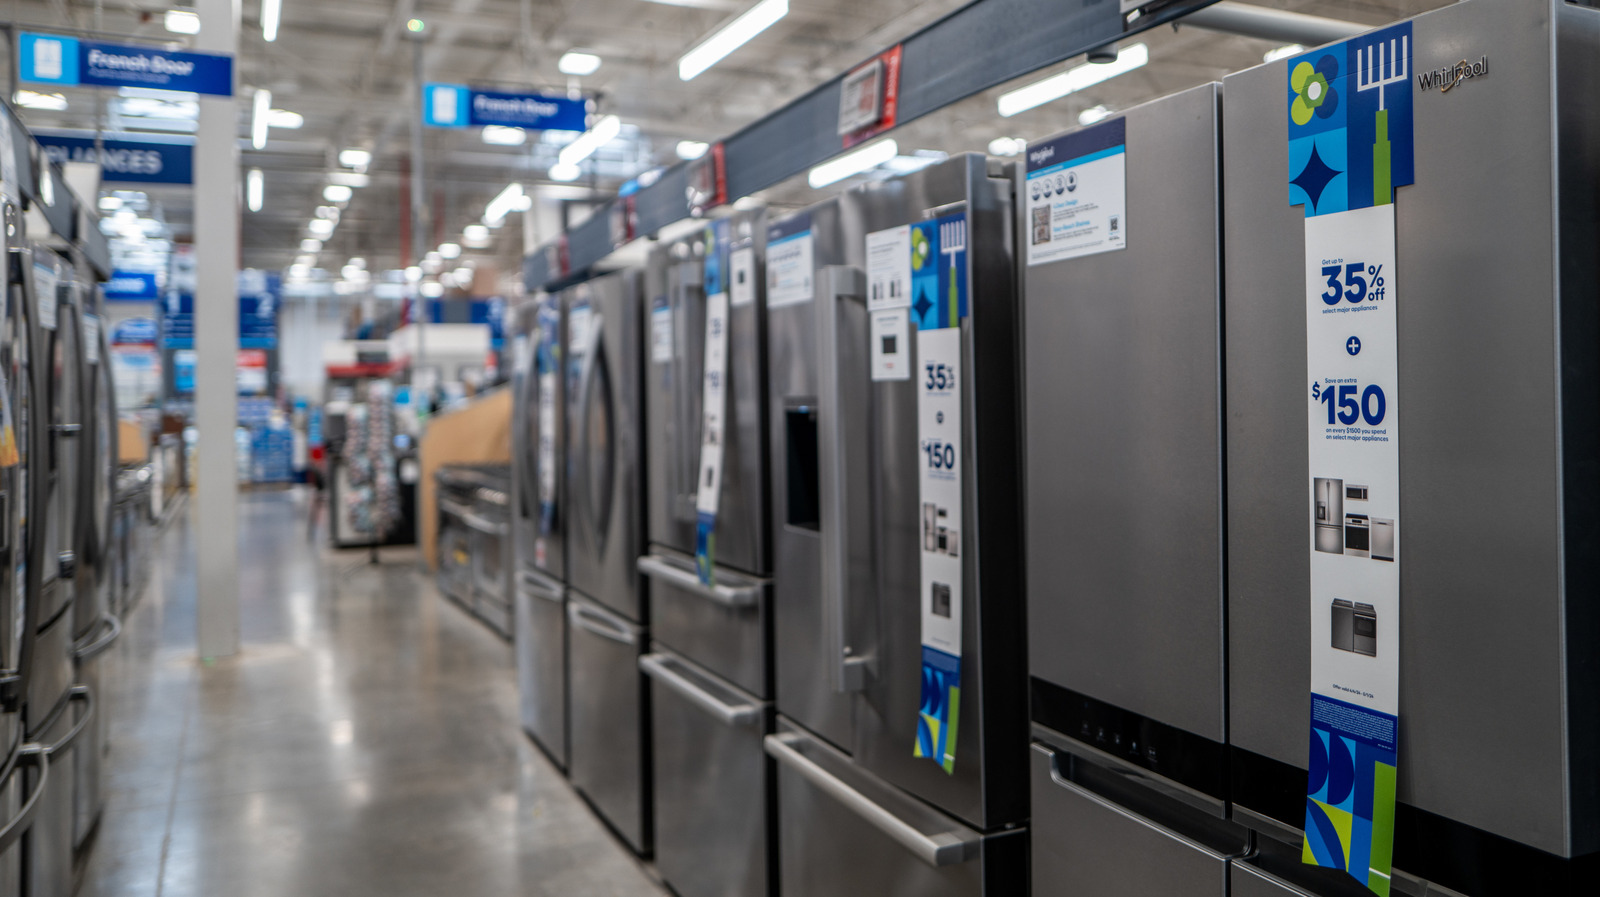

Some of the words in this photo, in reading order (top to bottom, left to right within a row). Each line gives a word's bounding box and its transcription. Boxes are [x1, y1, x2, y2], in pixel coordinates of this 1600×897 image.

[88, 48, 150, 70] French
[150, 54, 195, 76] Door
[1418, 55, 1488, 92] Whirlpool
[45, 145, 163, 174] PLIANCES
[1321, 262, 1384, 305] 35%
[1368, 288, 1385, 301] off
[1312, 382, 1386, 426] $150
